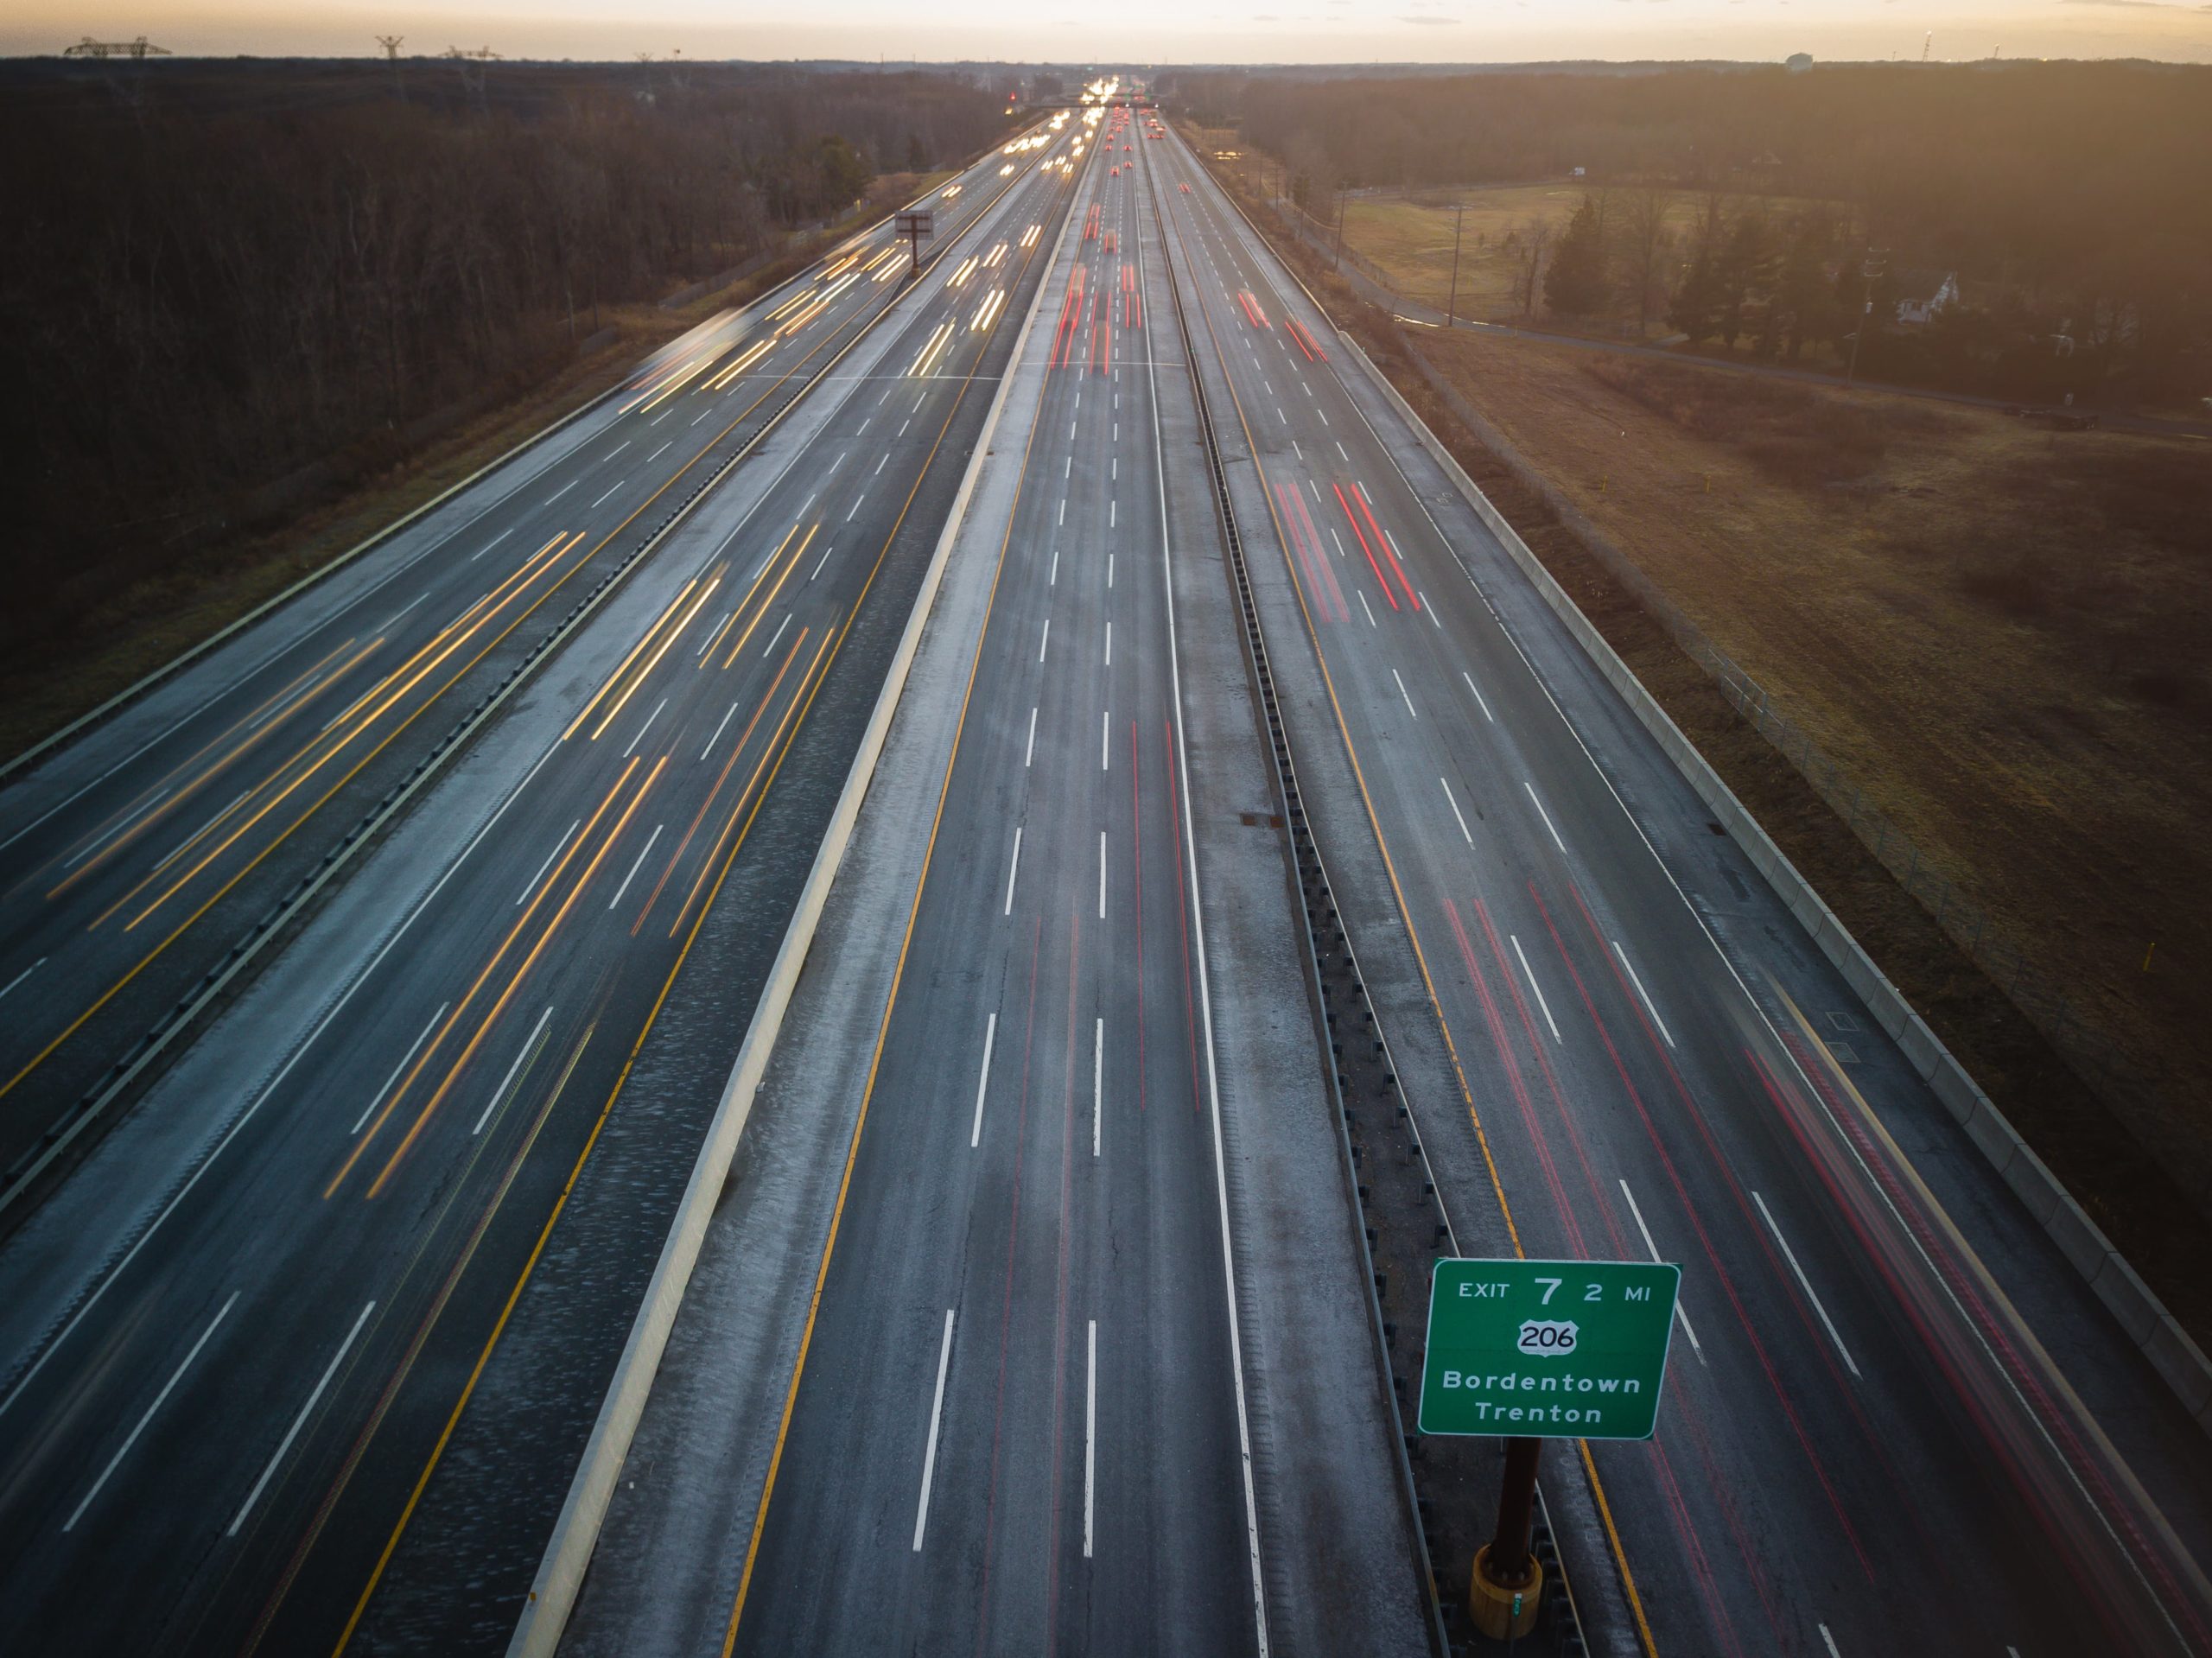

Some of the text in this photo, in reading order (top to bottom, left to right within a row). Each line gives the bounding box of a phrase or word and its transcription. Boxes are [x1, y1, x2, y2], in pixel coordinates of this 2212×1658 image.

[1459, 1278, 1651, 1305] EXIT 7 2 MI
[1520, 1325, 1575, 1348] 206
[1443, 1370, 1640, 1393] Bordentown
[1475, 1402, 1601, 1422] Trenton
